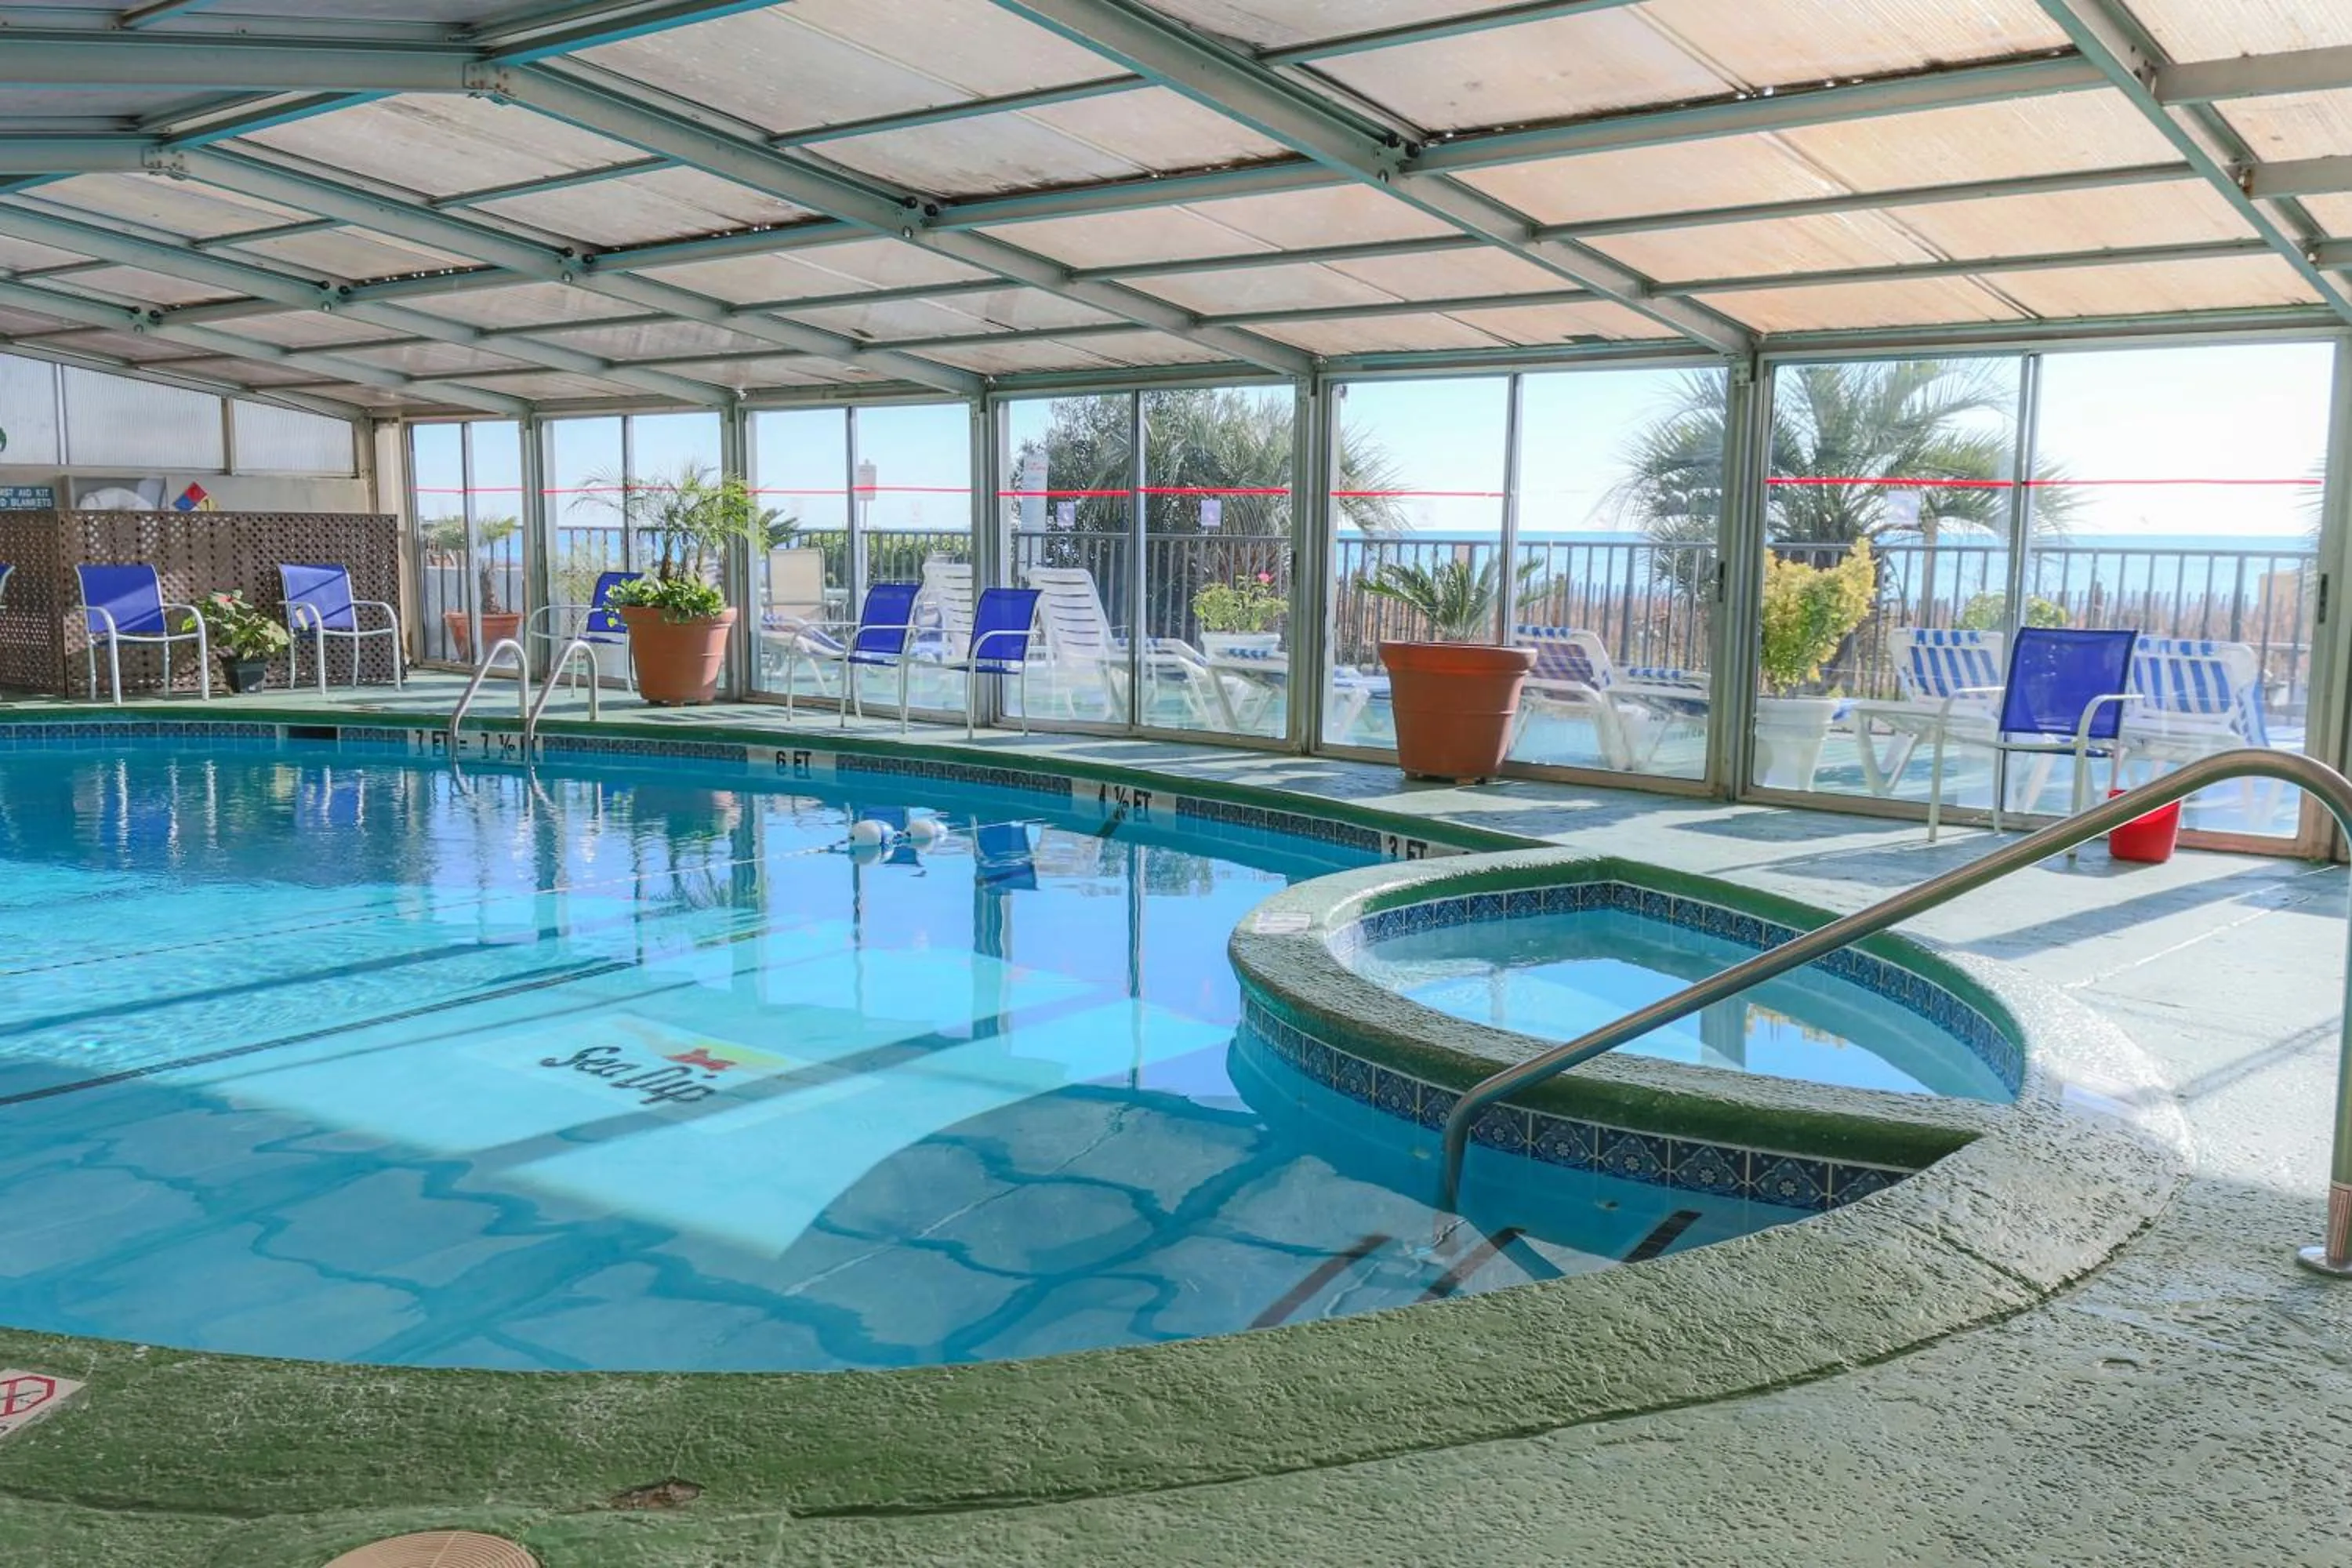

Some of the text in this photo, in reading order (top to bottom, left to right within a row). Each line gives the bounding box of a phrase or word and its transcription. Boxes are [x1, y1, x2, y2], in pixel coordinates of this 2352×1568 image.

[775, 750, 812, 768] 6 FT
[1134, 789, 1152, 809] FT
[1407, 840, 1428, 861] FT
[539, 1046, 717, 1105] Sea Dip
